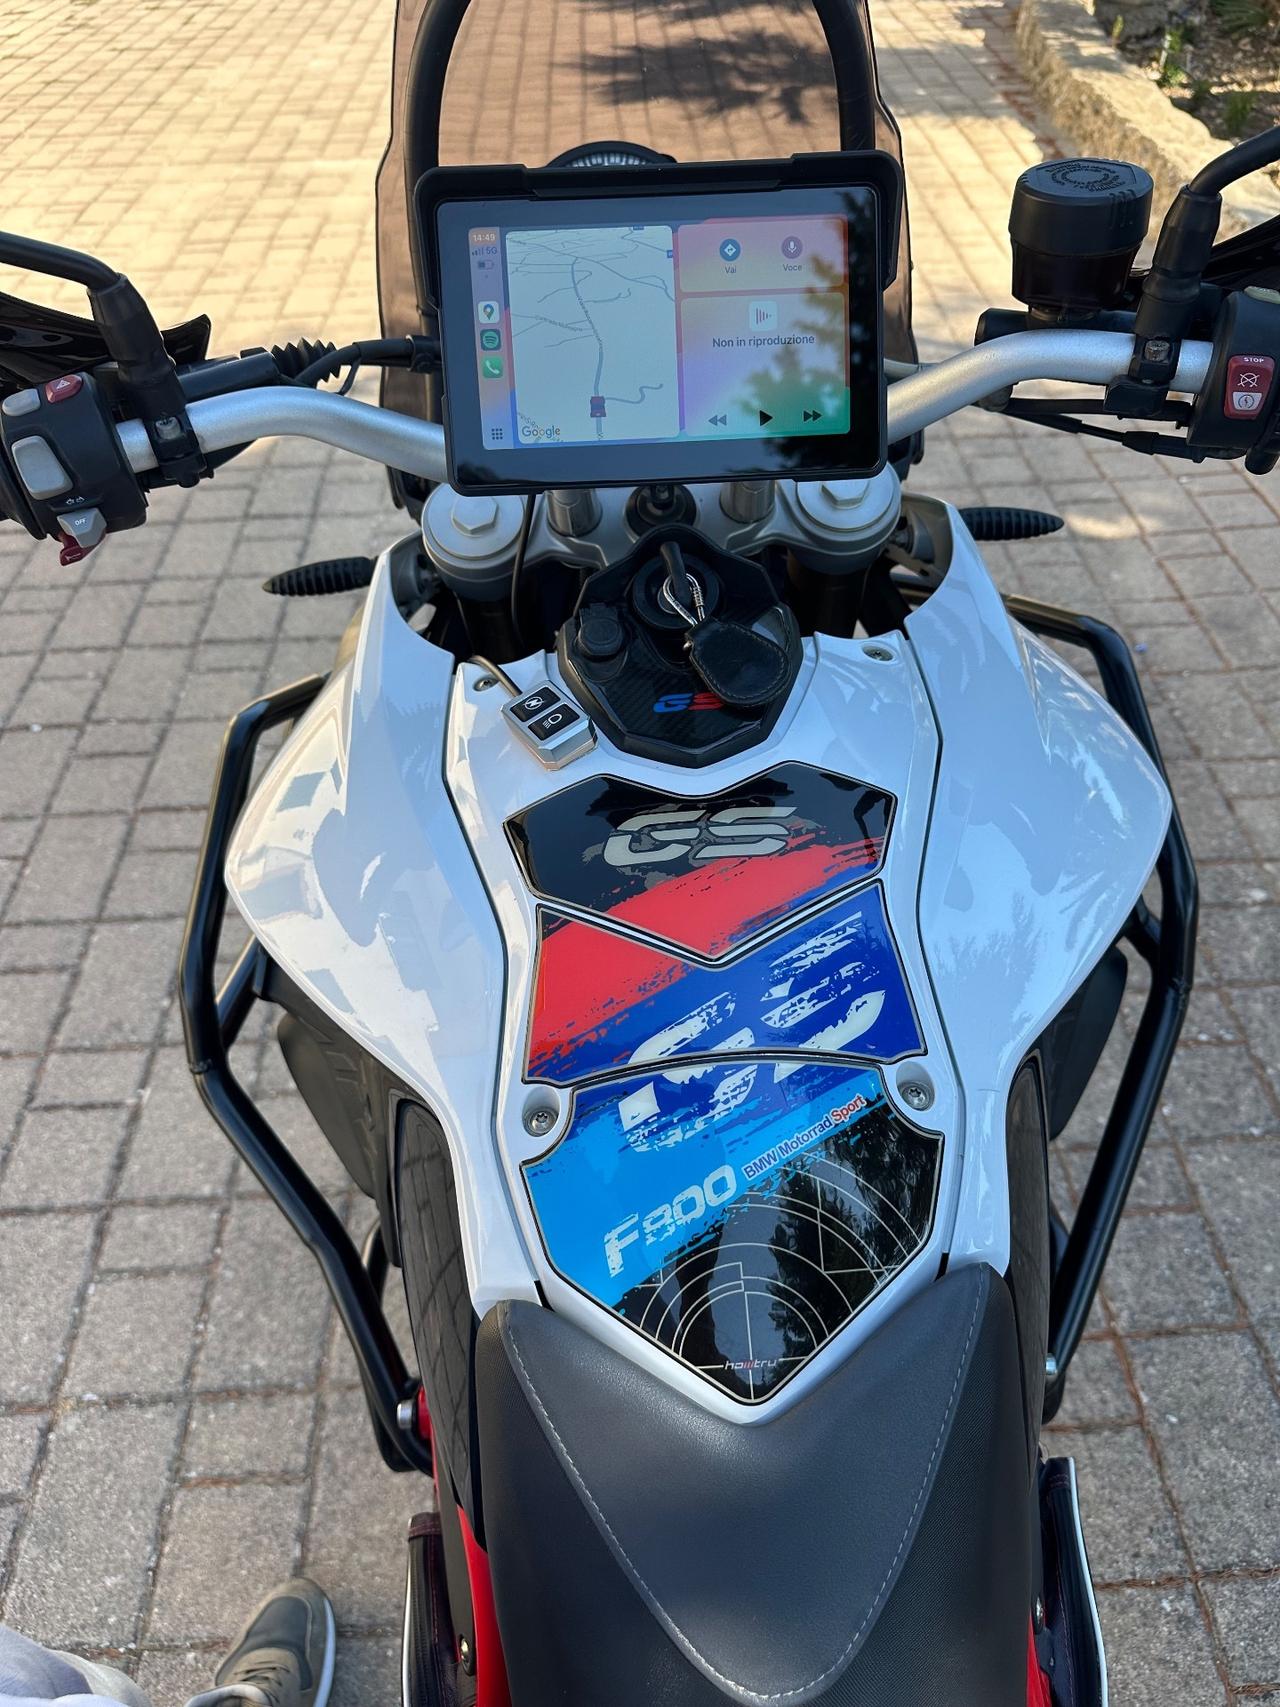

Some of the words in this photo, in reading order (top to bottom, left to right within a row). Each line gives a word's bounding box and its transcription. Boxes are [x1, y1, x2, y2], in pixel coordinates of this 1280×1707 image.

[472, 233, 496, 242] 14:49
[486, 246, 498, 255] 5G
[724, 266, 737, 274] Vai
[782, 264, 802, 272] Voce
[712, 338, 734, 348] Non
[736, 336, 746, 346] in
[748, 333, 816, 348] riproduzione
[521, 425, 561, 438] Google
[74, 518, 87, 526] OFF
[603, 806, 798, 867] GS
[742, 1148, 779, 1180] BMW
[777, 1114, 834, 1158] Motorrad
[830, 1093, 867, 1122] Sport
[603, 1163, 737, 1279] F800
